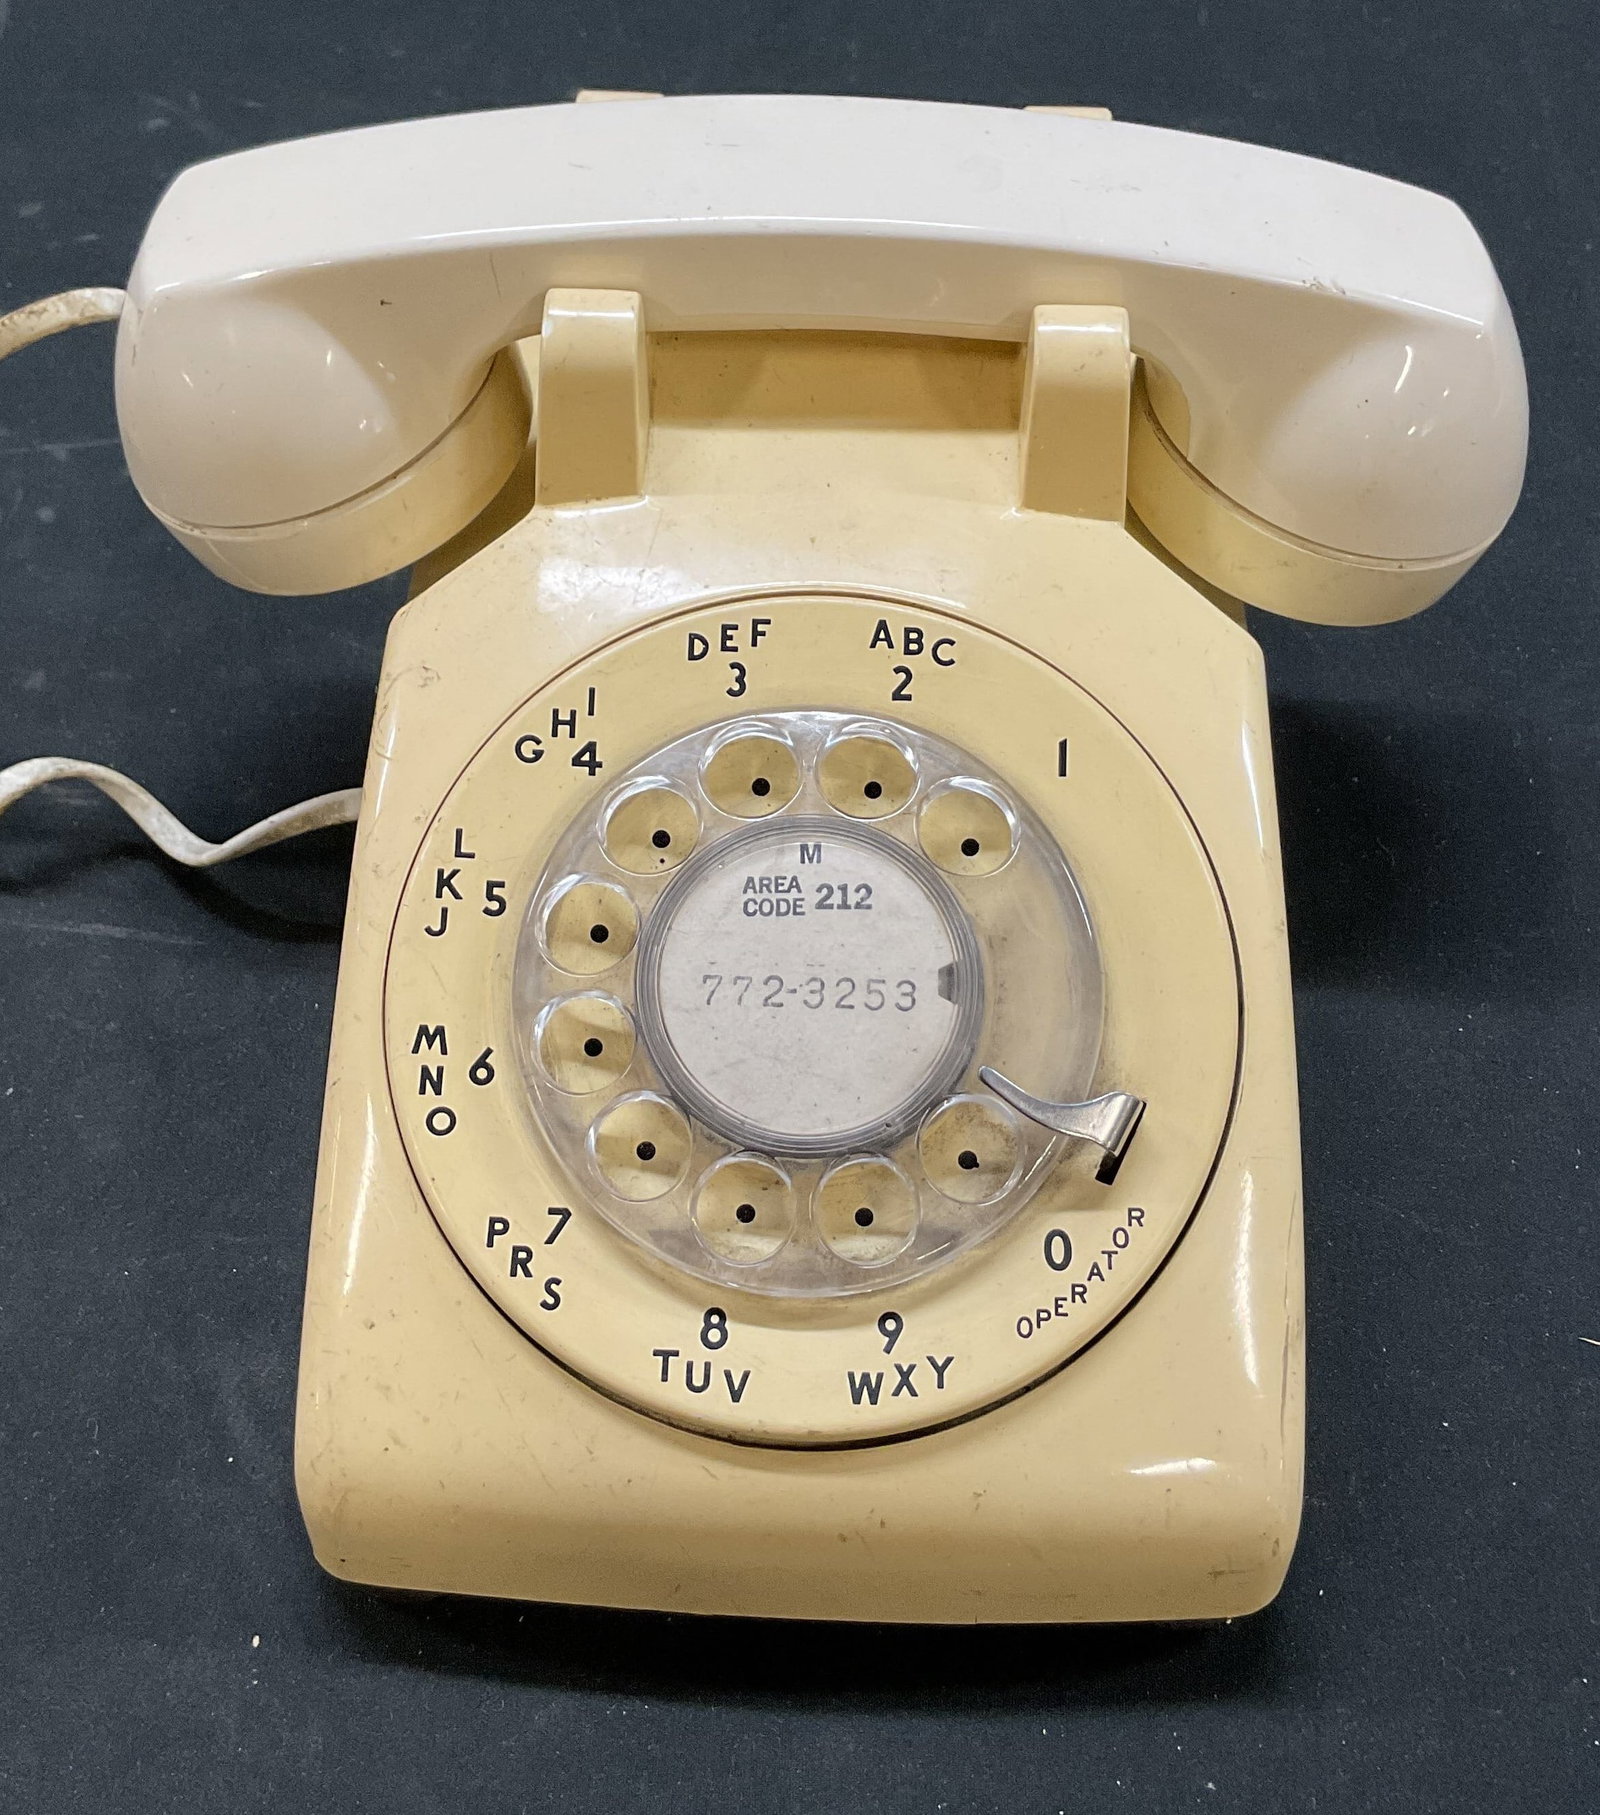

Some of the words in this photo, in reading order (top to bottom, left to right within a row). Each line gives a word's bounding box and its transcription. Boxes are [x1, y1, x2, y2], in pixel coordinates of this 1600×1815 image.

[688, 618, 771, 662] DEF
[869, 619, 957, 667] ABC
[726, 662, 747, 698] 3
[892, 666, 914, 702] 2
[571, 741, 604, 777] 4
[799, 843, 822, 865] M
[482, 880, 507, 918] 5
[743, 876, 803, 895] AREA
[815, 883, 873, 910] 212
[743, 898, 806, 917] CODE
[702, 974, 917, 1012] 772-3253
[469, 1047, 496, 1087] 6
[544, 1207, 573, 1246] 7
[1044, 1229, 1072, 1271] 0
[1016, 1207, 1145, 1339] OPERATOR
[700, 1307, 728, 1350] 8
[878, 1312, 904, 1356] 9
[653, 1349, 752, 1405] TUV
[848, 1356, 955, 1406] WXY
